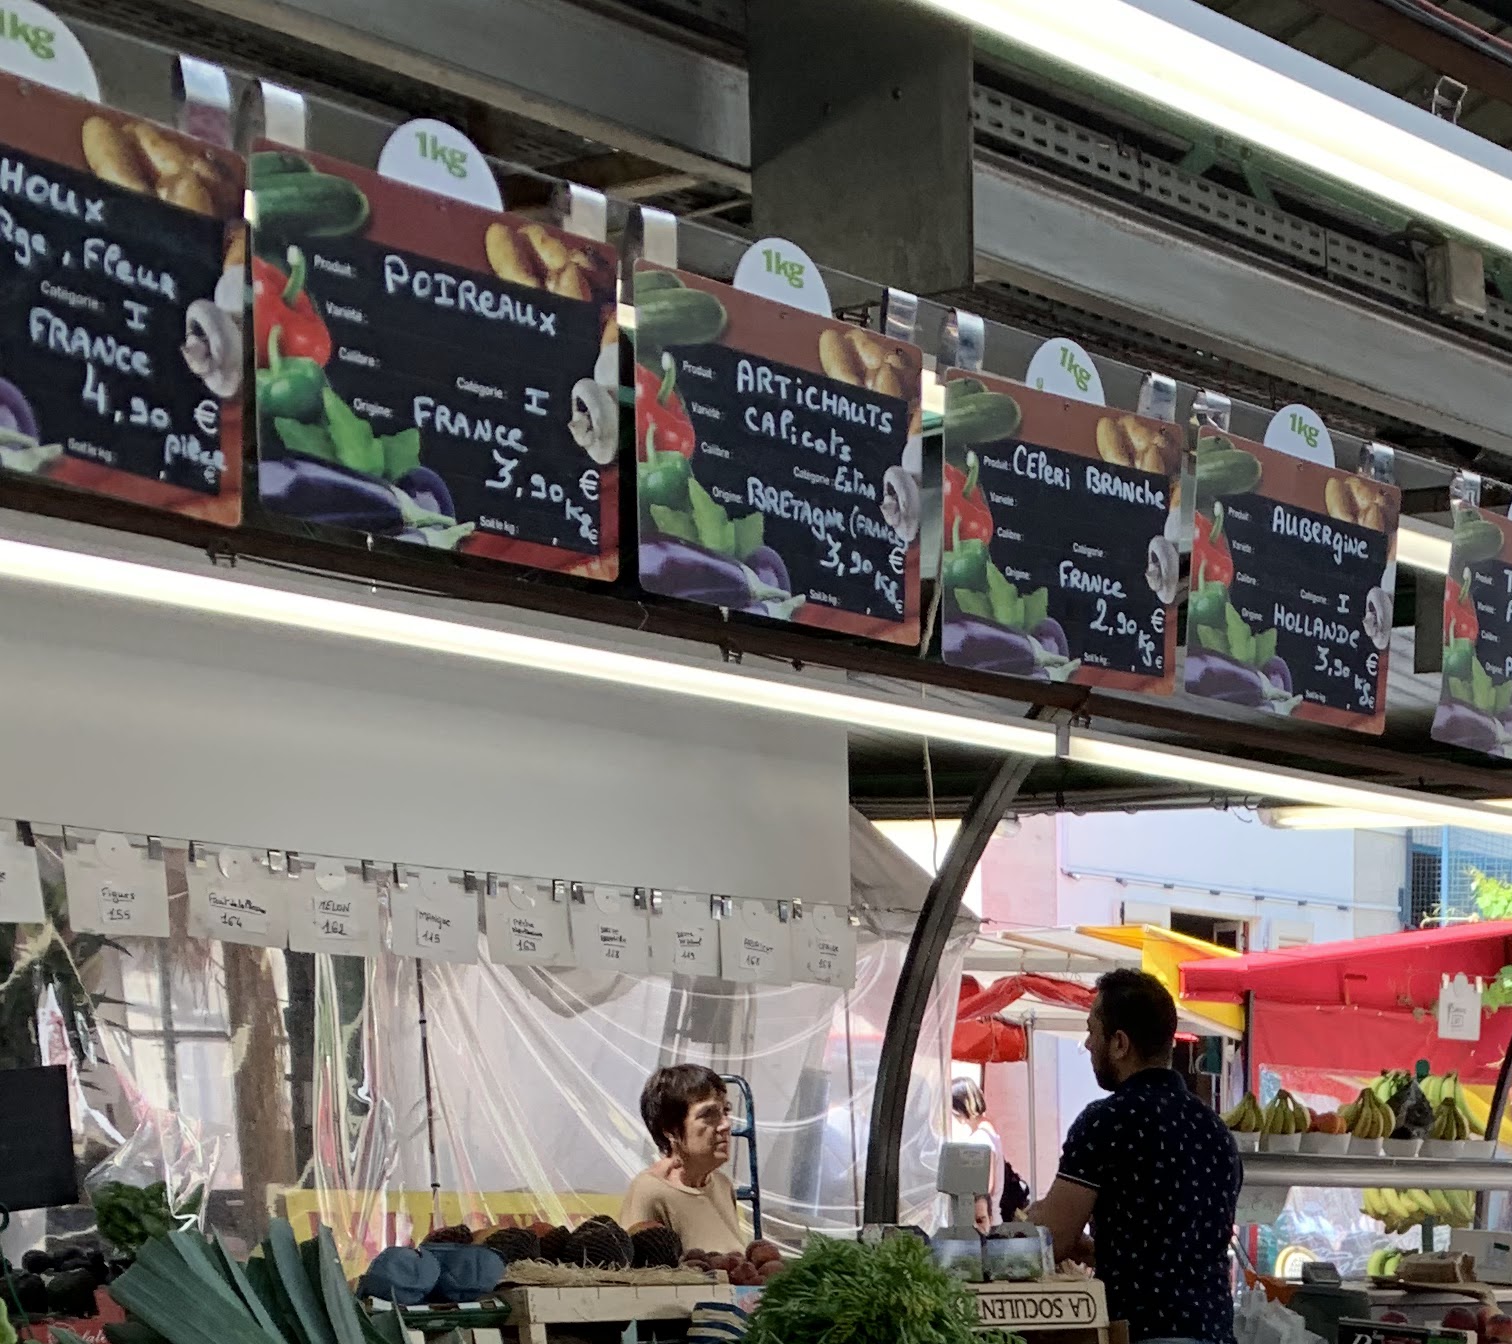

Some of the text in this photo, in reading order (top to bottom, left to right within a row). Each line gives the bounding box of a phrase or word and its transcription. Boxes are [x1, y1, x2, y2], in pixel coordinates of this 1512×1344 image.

[413, 131, 469, 179] 1kg
[761, 248, 806, 290] 1kg
[1059, 345, 1093, 393] 1kg
[193, 399, 219, 435] €
[1288, 412, 1321, 449] 1kg
[578, 469, 600, 501] €
[1089, 597, 1165, 637] 2,90 €
[1365, 652, 1379, 677] €
[979, 1297, 1092, 1319] LA SOCULEN
